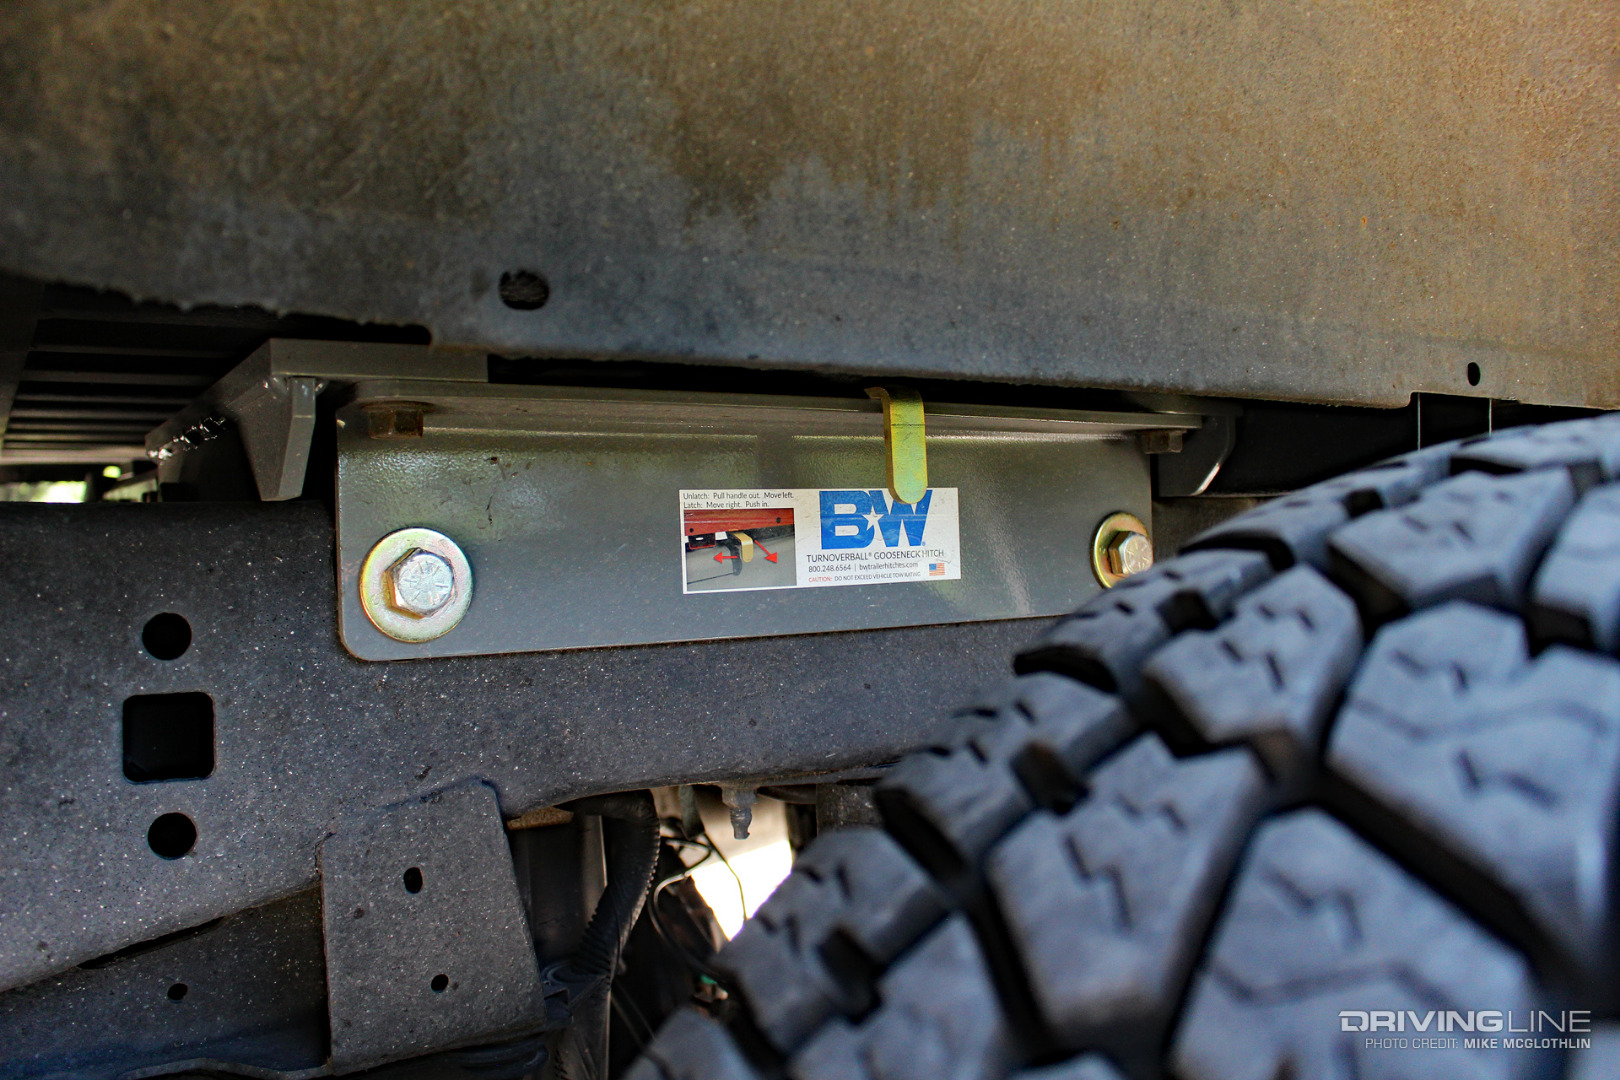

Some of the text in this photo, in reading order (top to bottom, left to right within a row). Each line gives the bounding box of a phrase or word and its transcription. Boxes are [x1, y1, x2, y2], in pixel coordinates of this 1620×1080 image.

[683, 492, 709, 500] Unlatch:
[782, 491, 794, 499] left.
[683, 501, 703, 509] Latch:
[725, 501, 742, 509] right.
[873, 550, 920, 560] GOOSENECK
[921, 549, 944, 558] HITCH
[808, 562, 918, 573] 800.248.6564 bwtrailerhitches.com
